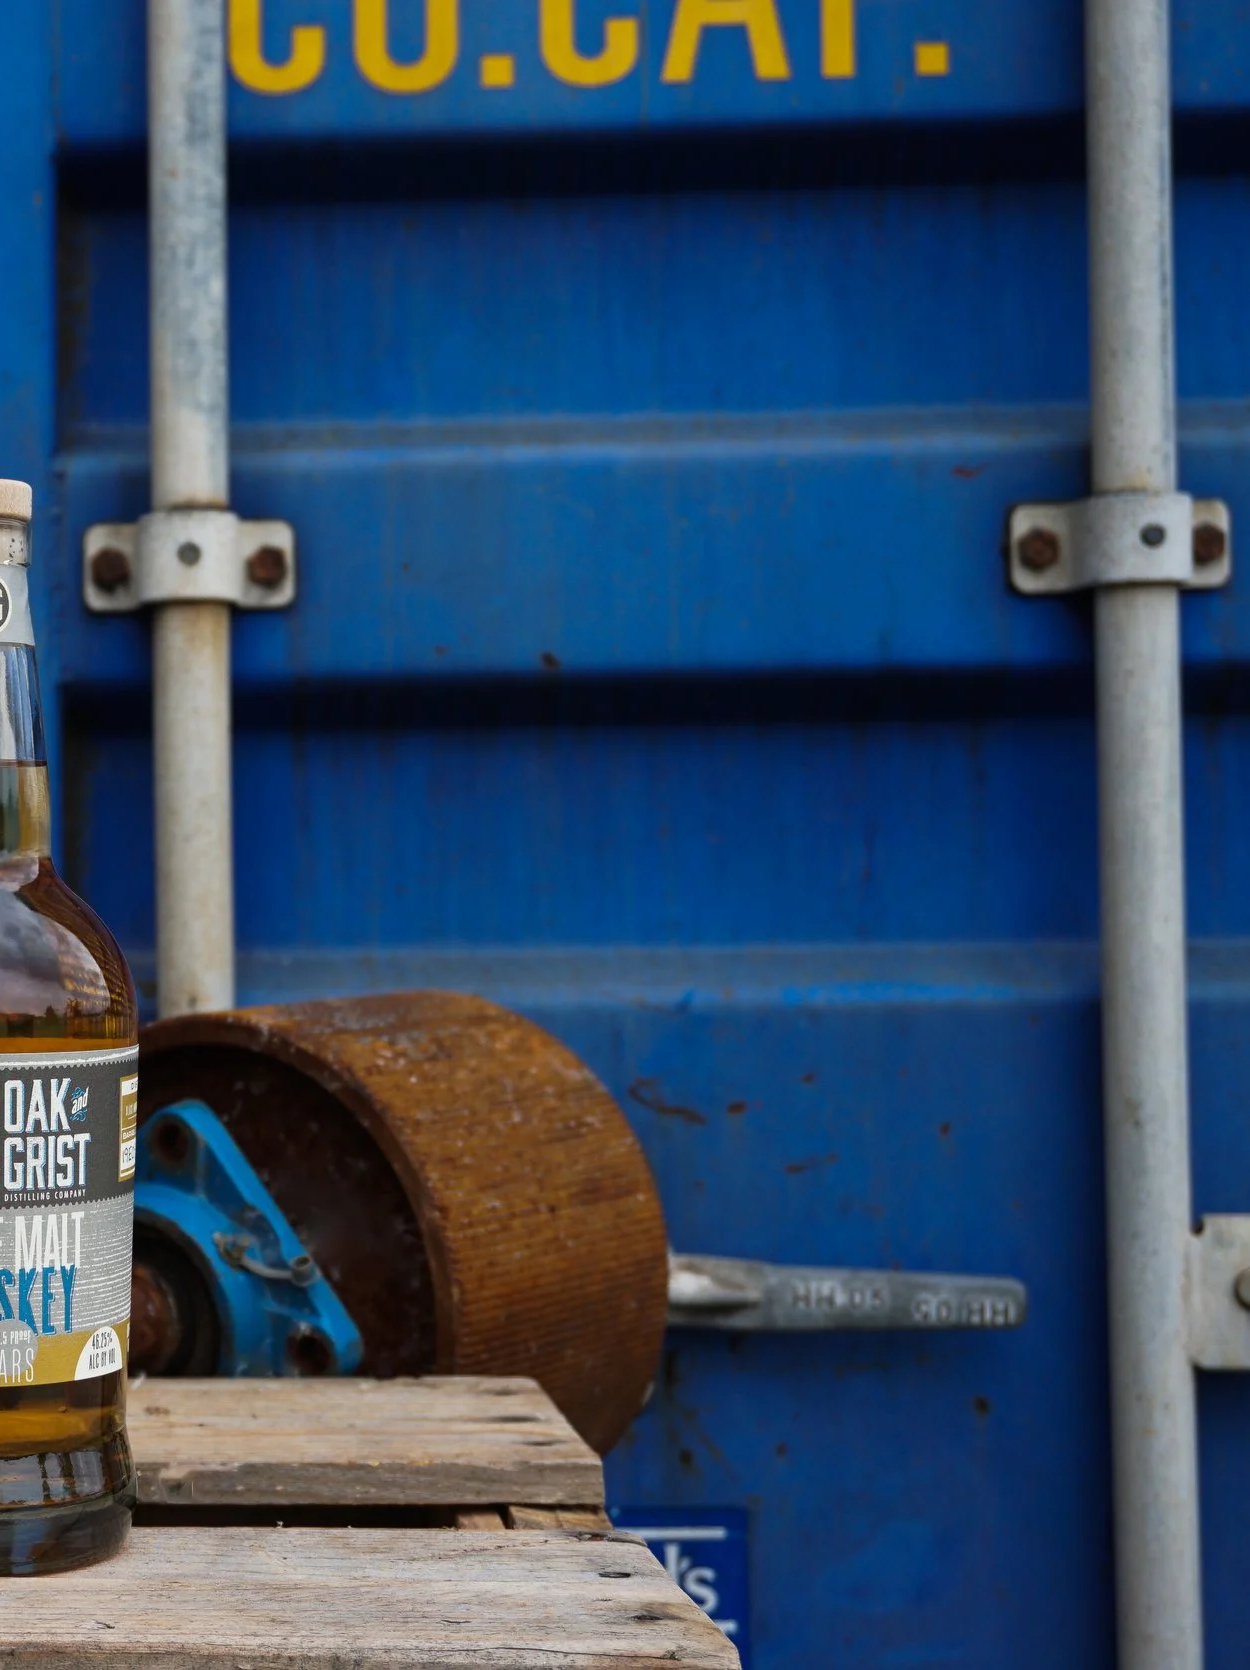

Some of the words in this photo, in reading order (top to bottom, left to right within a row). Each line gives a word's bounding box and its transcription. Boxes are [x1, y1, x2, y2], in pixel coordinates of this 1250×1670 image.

[3, 1077, 71, 1134] OAK
[71, 1086, 90, 1116] and
[3, 1132, 92, 1192] GRIST
[4, 1191, 51, 1202] DISTILLING
[54, 1188, 87, 1200] COMPANY
[14, 1211, 85, 1274] MALT
[91, 1330, 113, 1350] 46.25%
[88, 1352, 100, 1370] ALC
